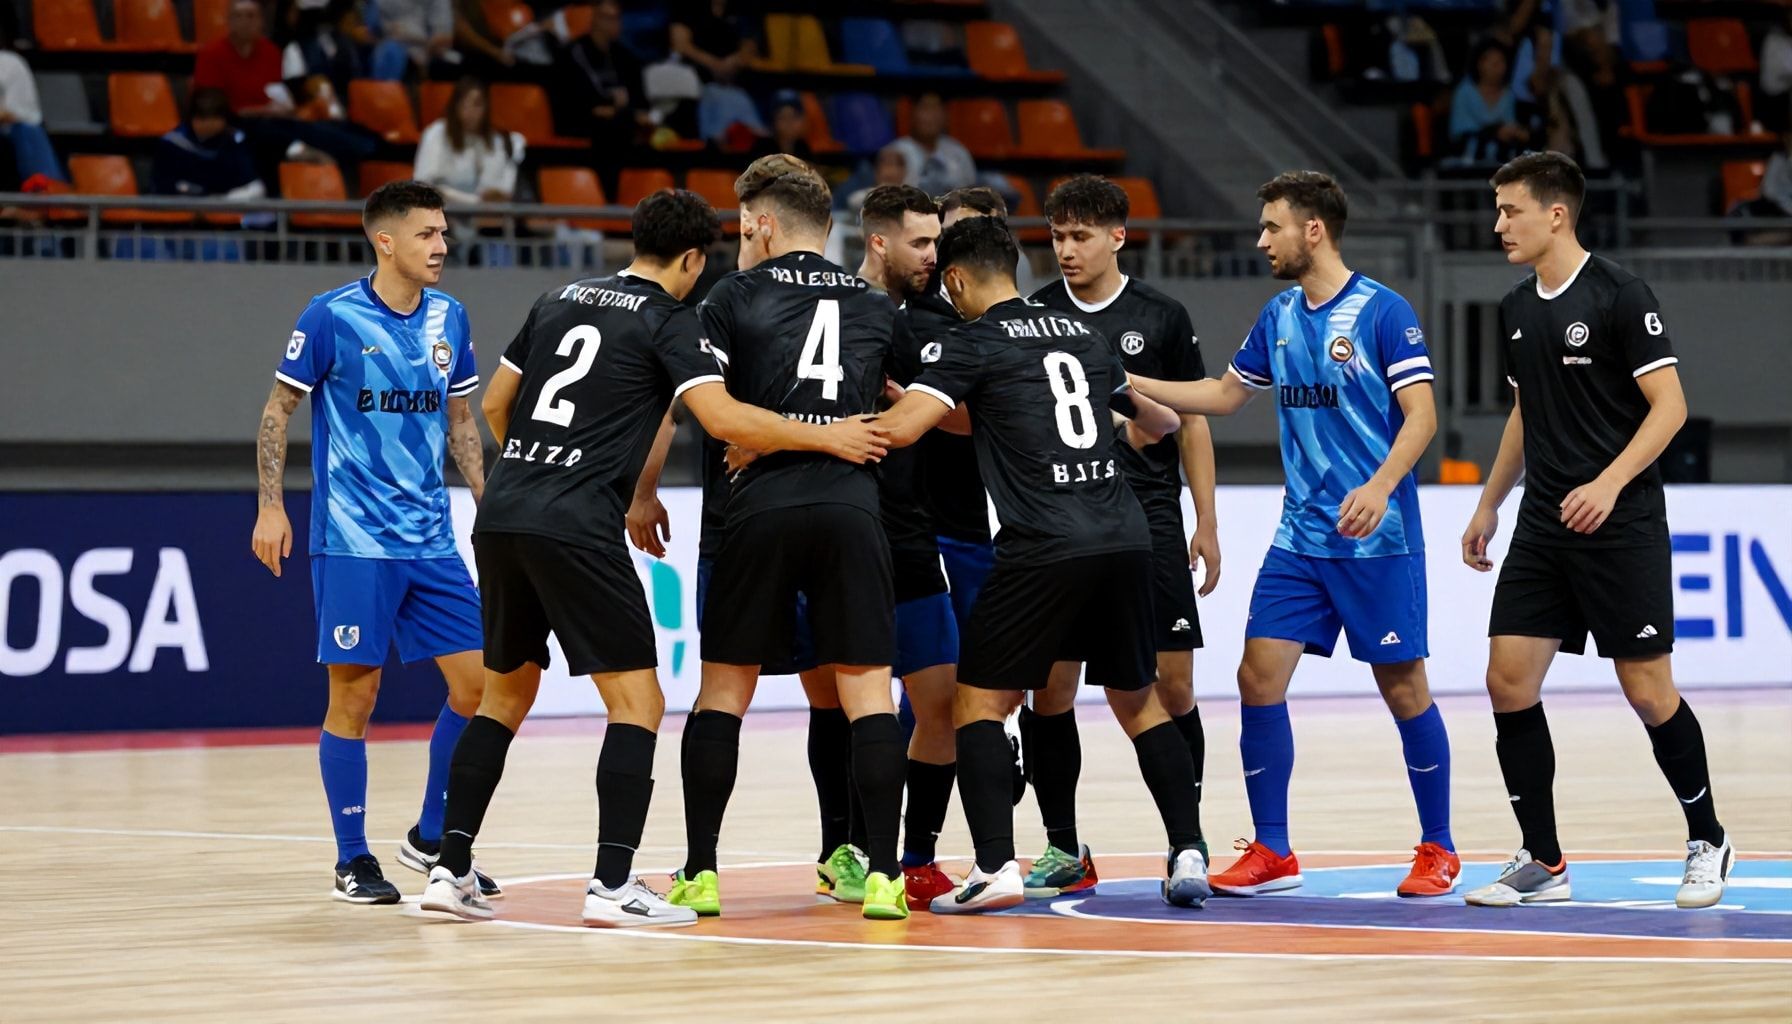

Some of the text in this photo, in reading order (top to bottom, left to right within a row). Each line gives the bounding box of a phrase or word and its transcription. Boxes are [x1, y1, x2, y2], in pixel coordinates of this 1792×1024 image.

[532, 324, 601, 428] 2
[797, 299, 844, 400] 4
[1043, 351, 1098, 449] 8
[0, 547, 209, 676] OSA
